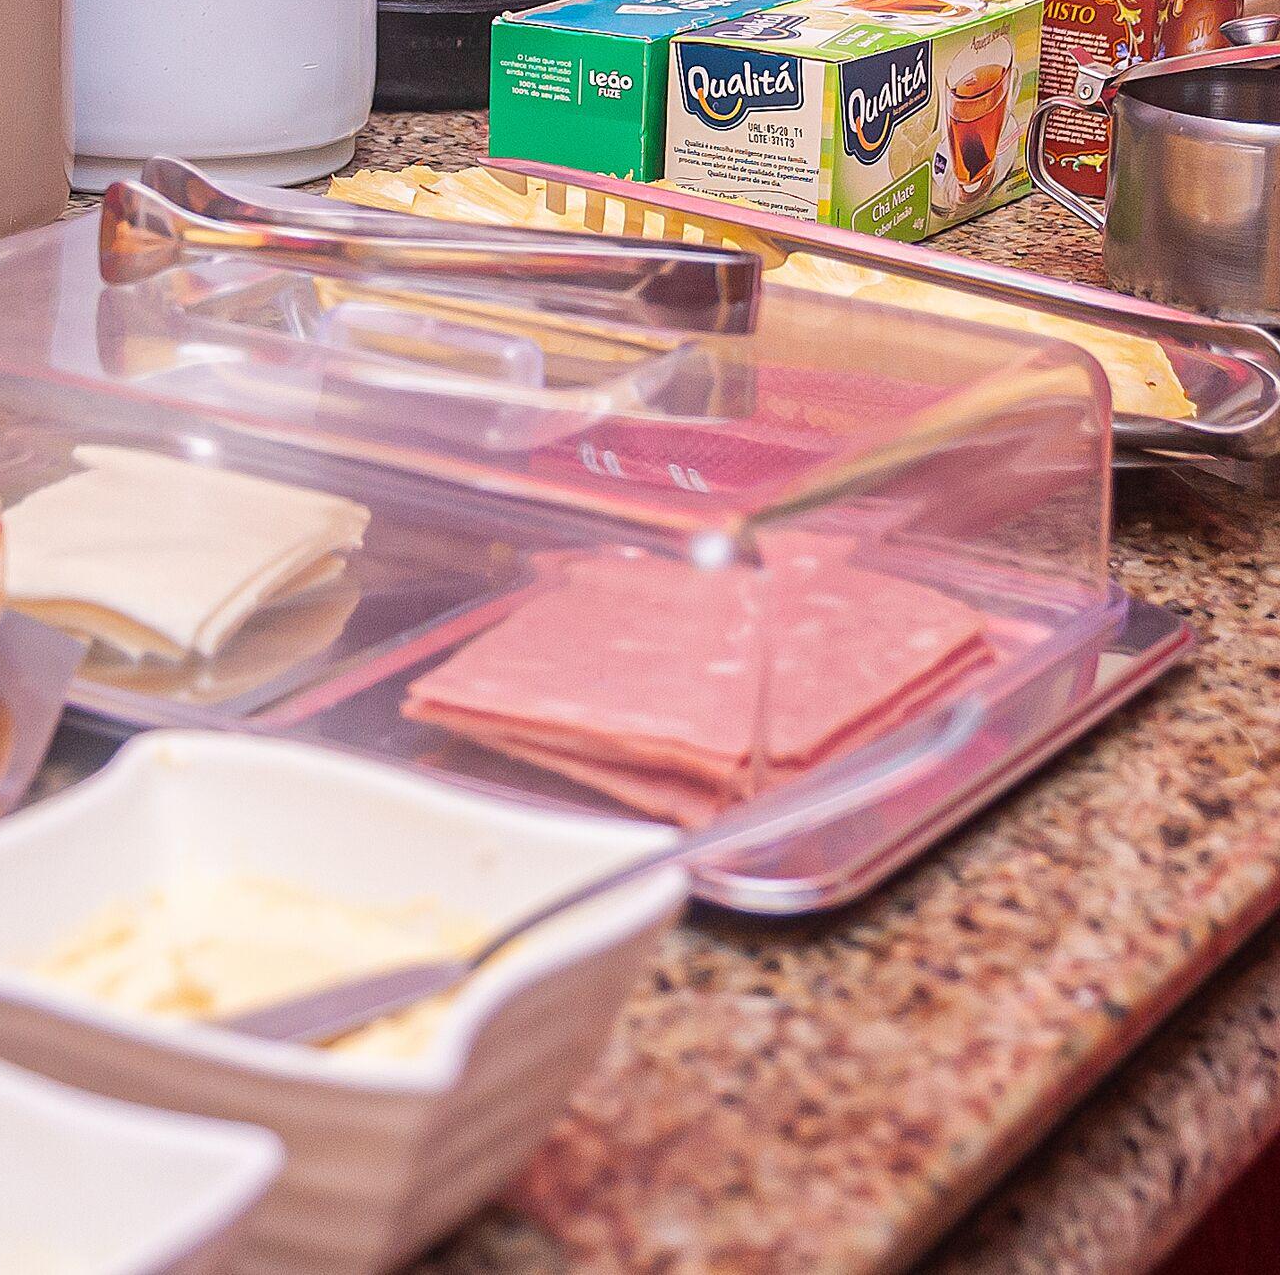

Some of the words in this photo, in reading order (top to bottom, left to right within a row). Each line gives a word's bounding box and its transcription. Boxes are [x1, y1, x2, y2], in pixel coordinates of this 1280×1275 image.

[598, 88, 622, 99] FUZE
[688, 61, 795, 105] Qualitá
[848, 48, 926, 133] Qualitá
[784, 205, 809, 214] qualquer
[872, 197, 890, 222] Chá
[892, 184, 914, 209] Mate
[894, 206, 912, 226] Limão
